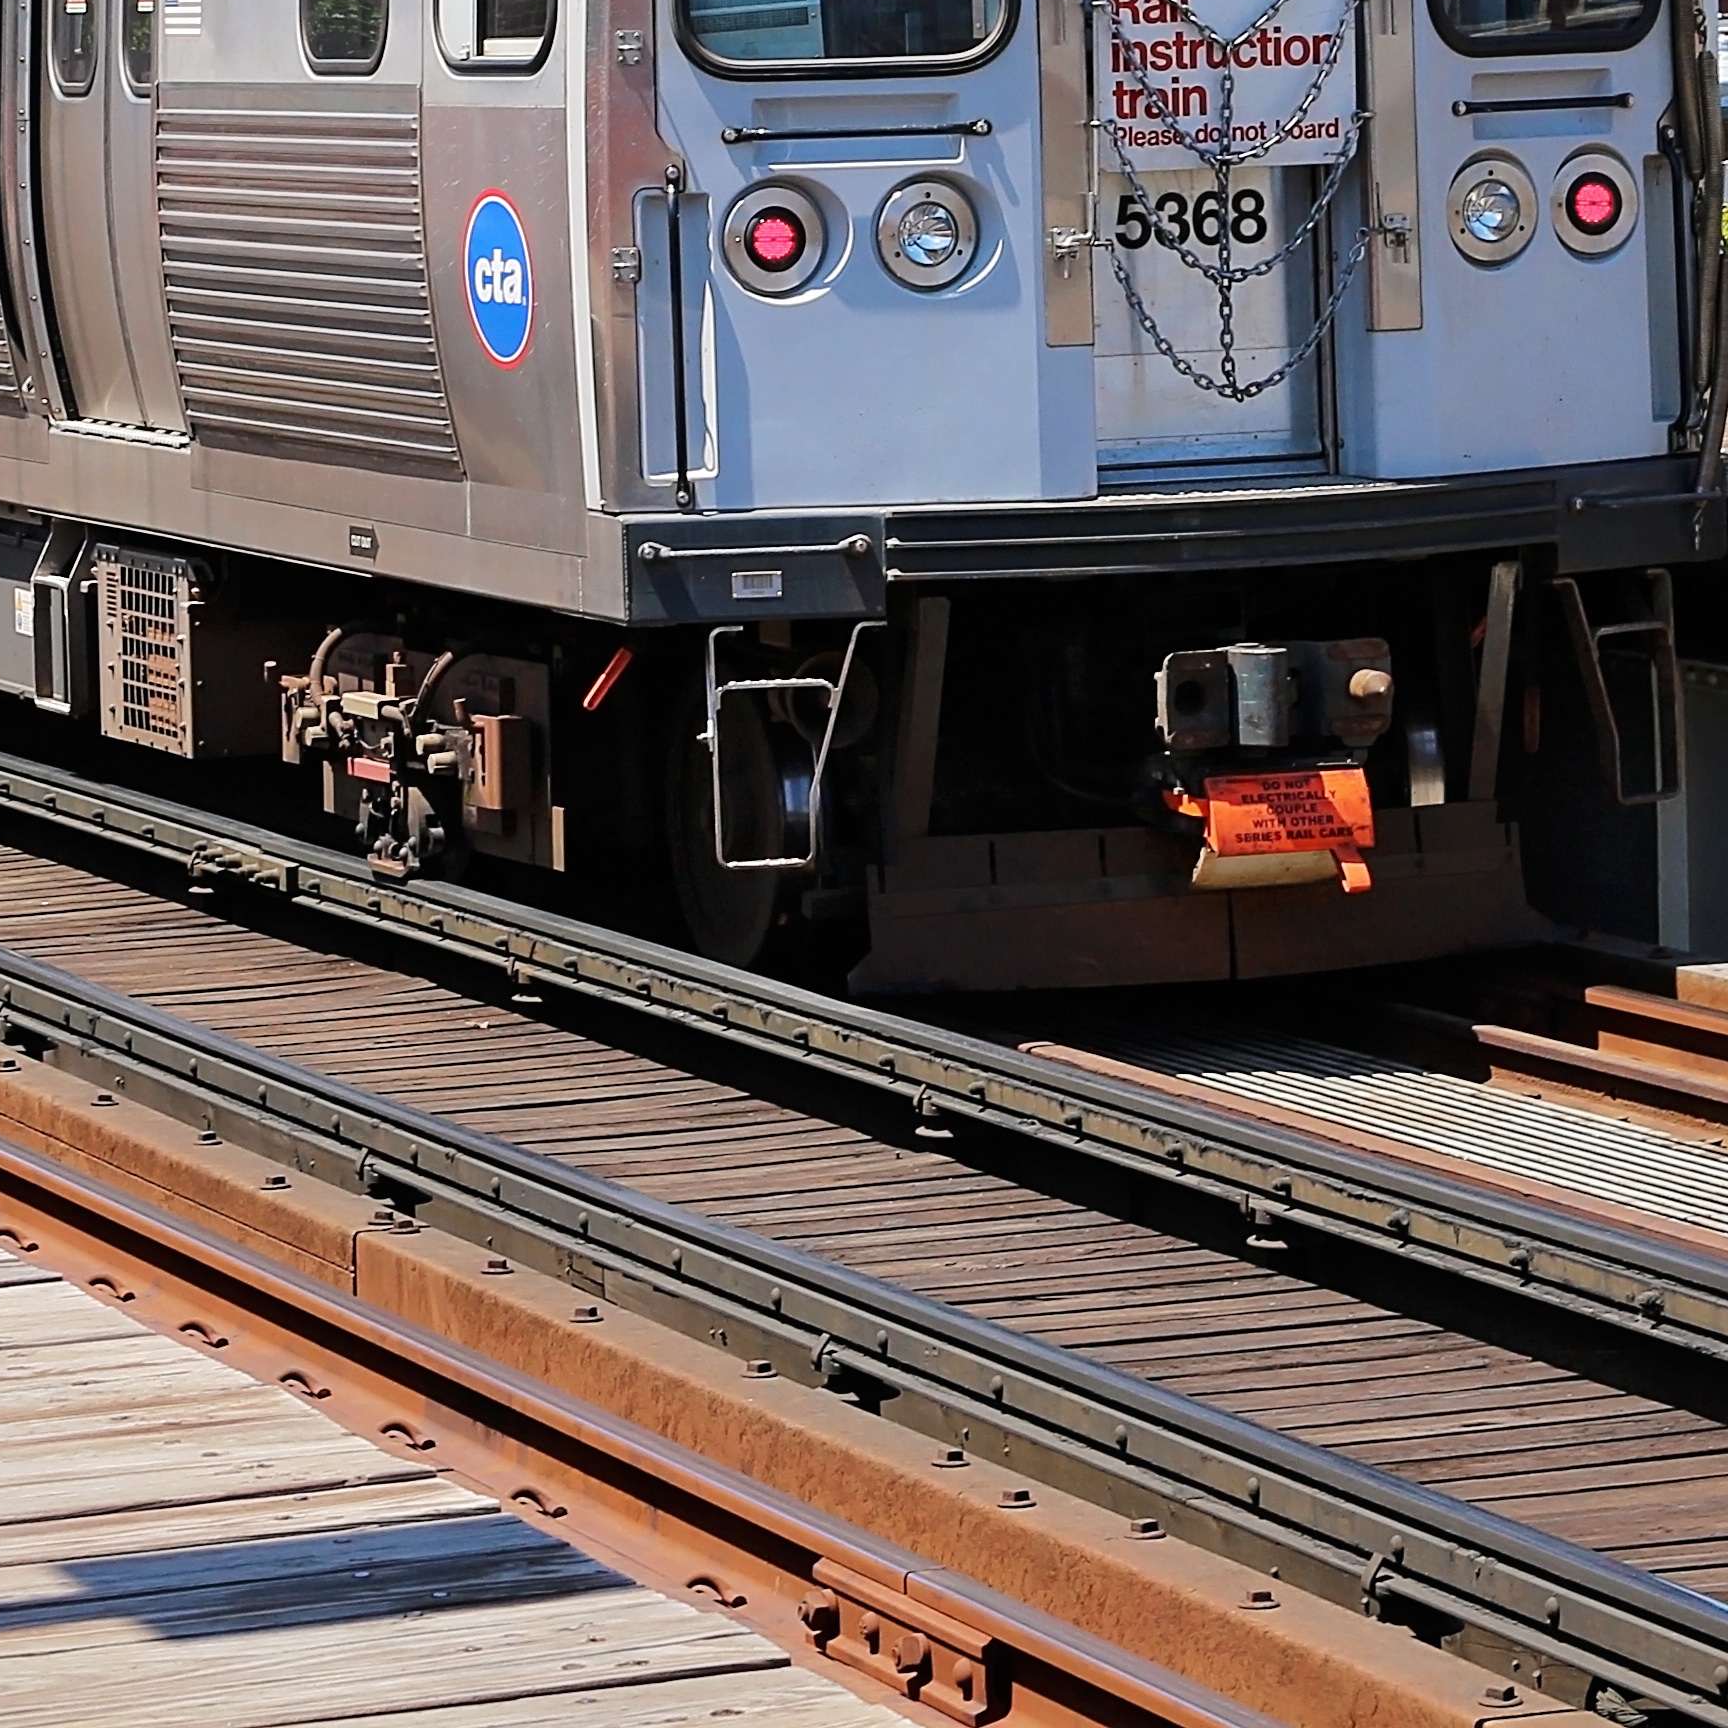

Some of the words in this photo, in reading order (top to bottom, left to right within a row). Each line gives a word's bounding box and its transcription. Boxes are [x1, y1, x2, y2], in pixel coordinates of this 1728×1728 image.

[1111, 26, 1338, 73] instruction
[1113, 76, 1207, 120] train
[1195, 123, 1223, 144] do
[1233, 121, 1267, 142] not
[1115, 189, 1268, 250] 5368
[474, 248, 523, 305] cta
[1262, 780, 1281, 791] DO
[1285, 779, 1309, 790] NOT
[1241, 790, 1336, 804] ELECTRICALLY
[1267, 803, 1318, 815] COUPLE
[1253, 818, 1286, 829] WITH
[1290, 815, 1334, 827] OTHER
[1235, 829, 1282, 843] SERIES
[1287, 828, 1315, 841] RAIL
[1320, 826, 1354, 838] CARS
